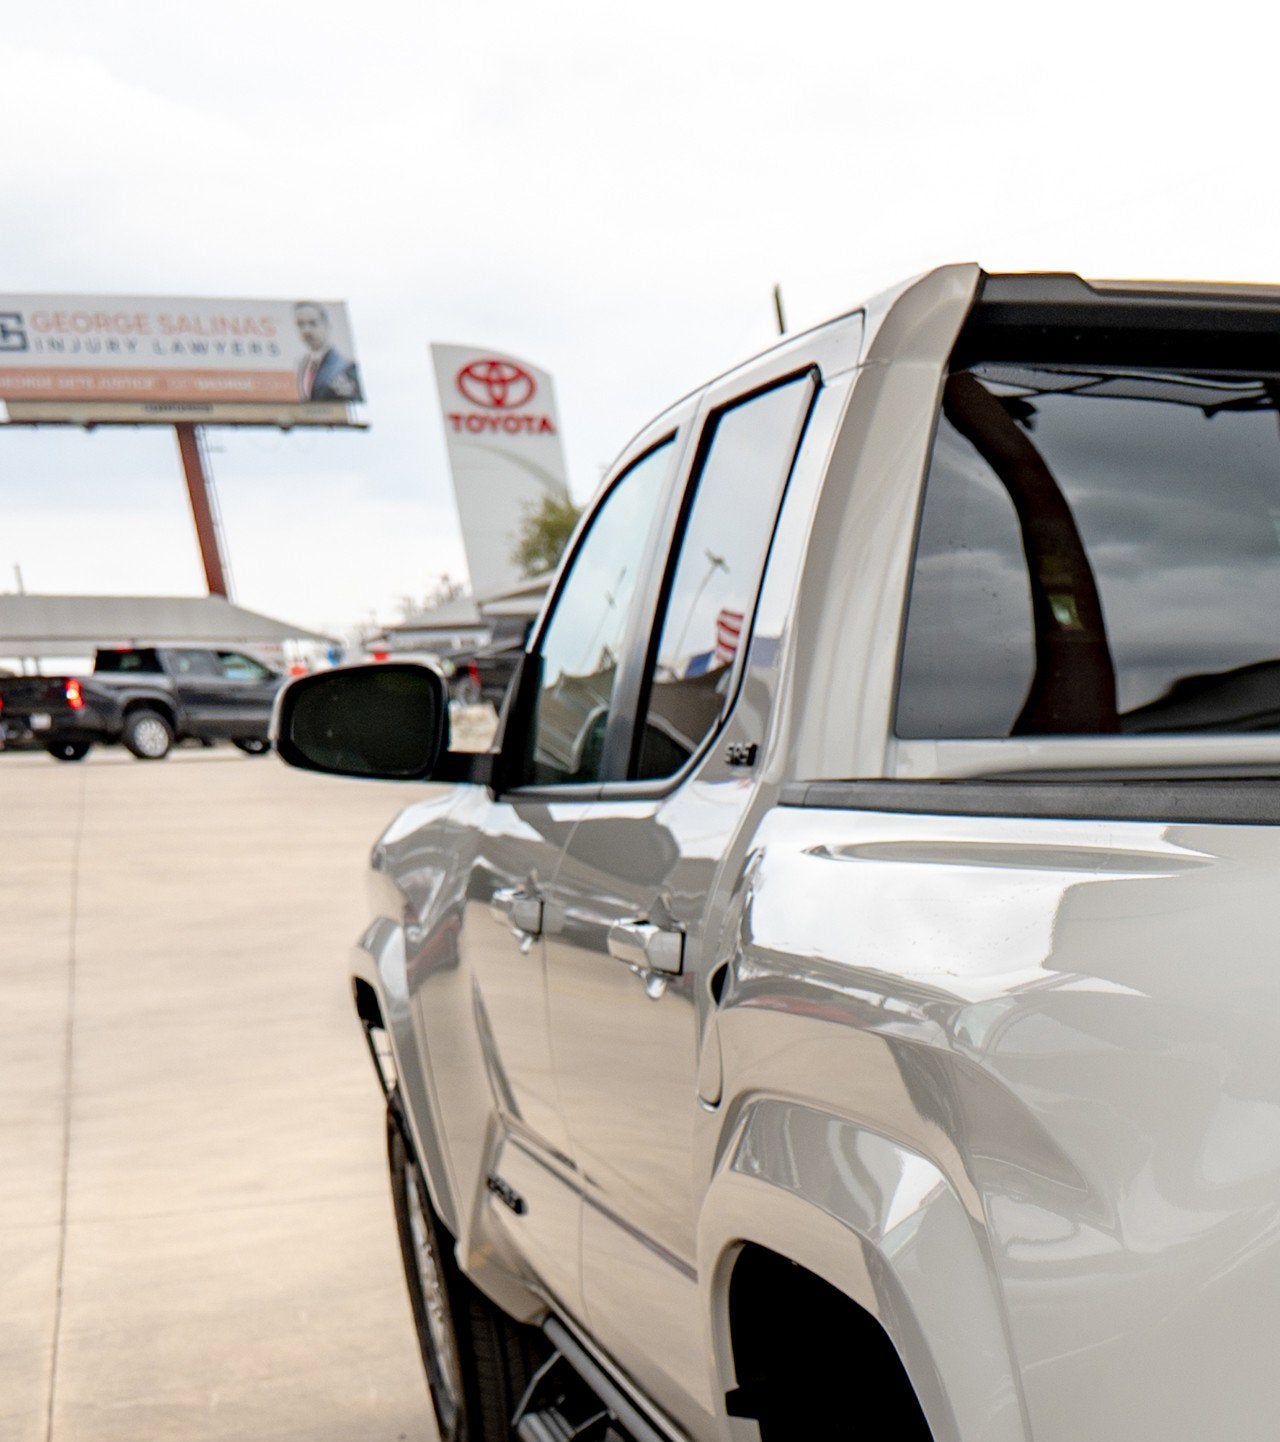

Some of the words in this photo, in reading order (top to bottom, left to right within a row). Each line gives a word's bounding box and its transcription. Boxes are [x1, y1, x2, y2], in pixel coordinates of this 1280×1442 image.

[30, 311, 150, 335] GEORGE
[157, 313, 277, 338] SALINAS
[34, 337, 138, 354] INJURY
[154, 339, 282, 357] LAWYERS
[449, 412, 556, 436] TOYOTA
